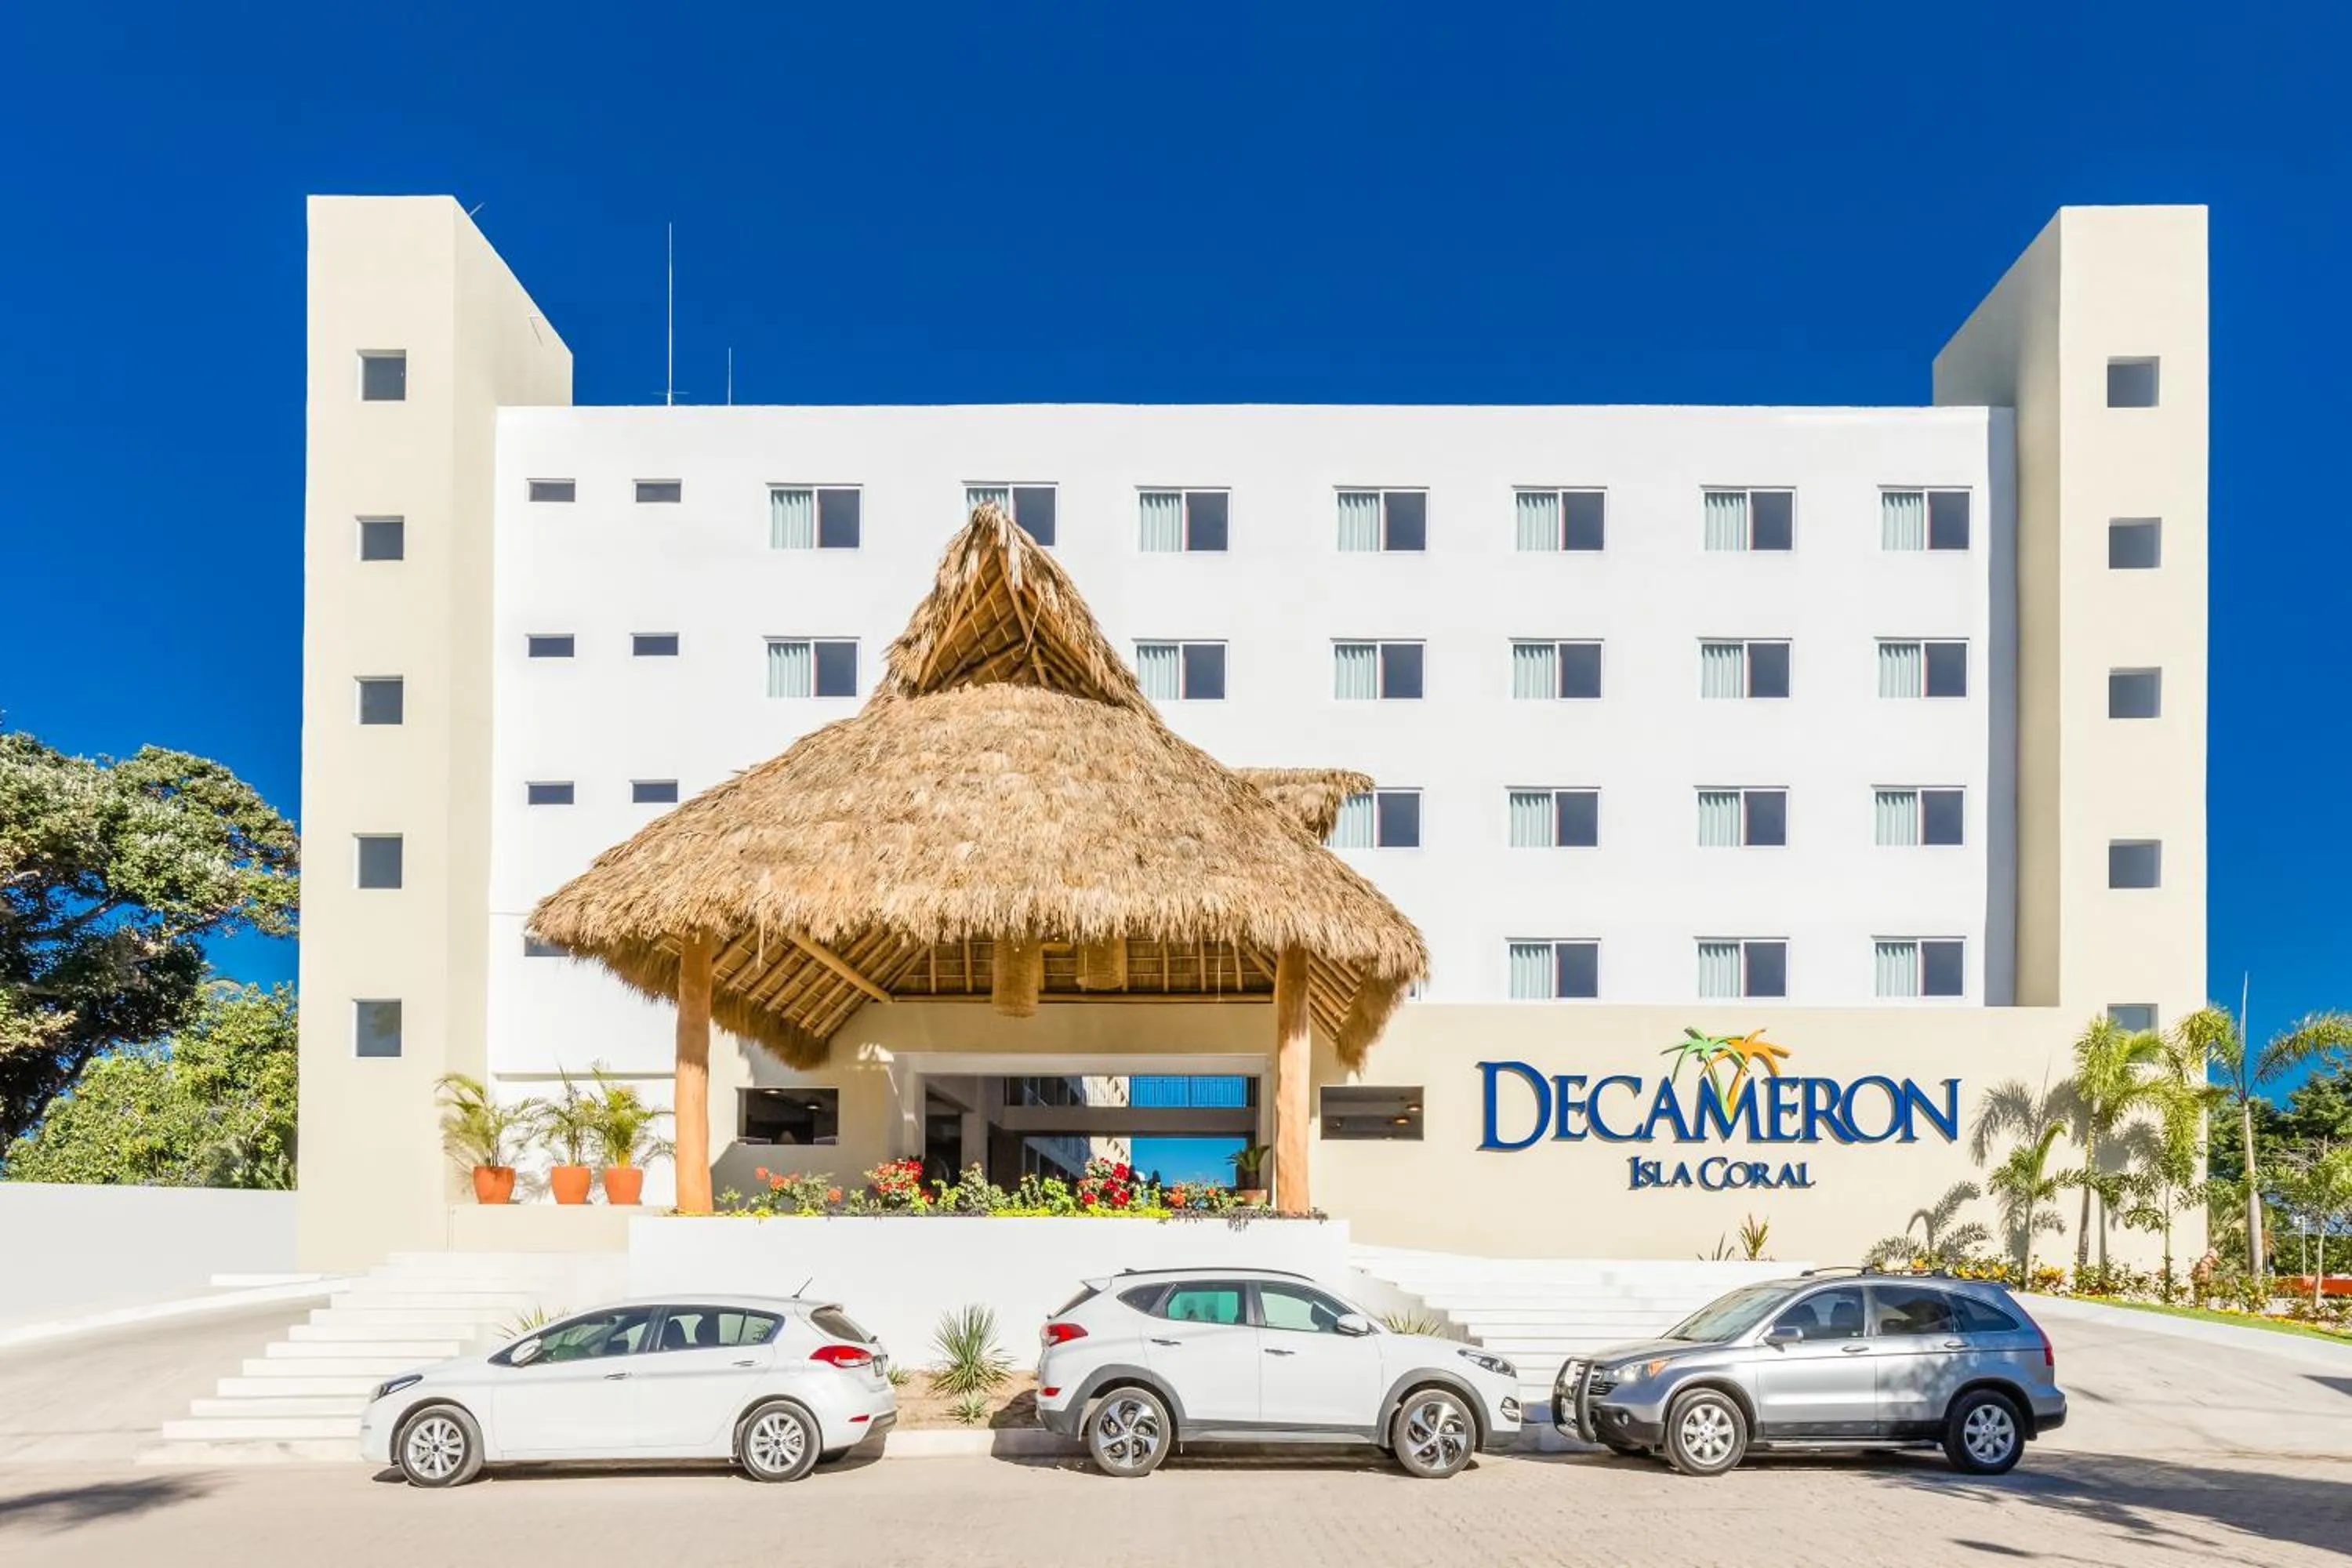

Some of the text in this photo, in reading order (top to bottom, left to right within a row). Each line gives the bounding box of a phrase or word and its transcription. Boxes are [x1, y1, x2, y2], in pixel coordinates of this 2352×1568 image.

[1477, 1061, 1962, 1150] DECAMERON
[1628, 1156, 1816, 1191] ISLA CORAL
